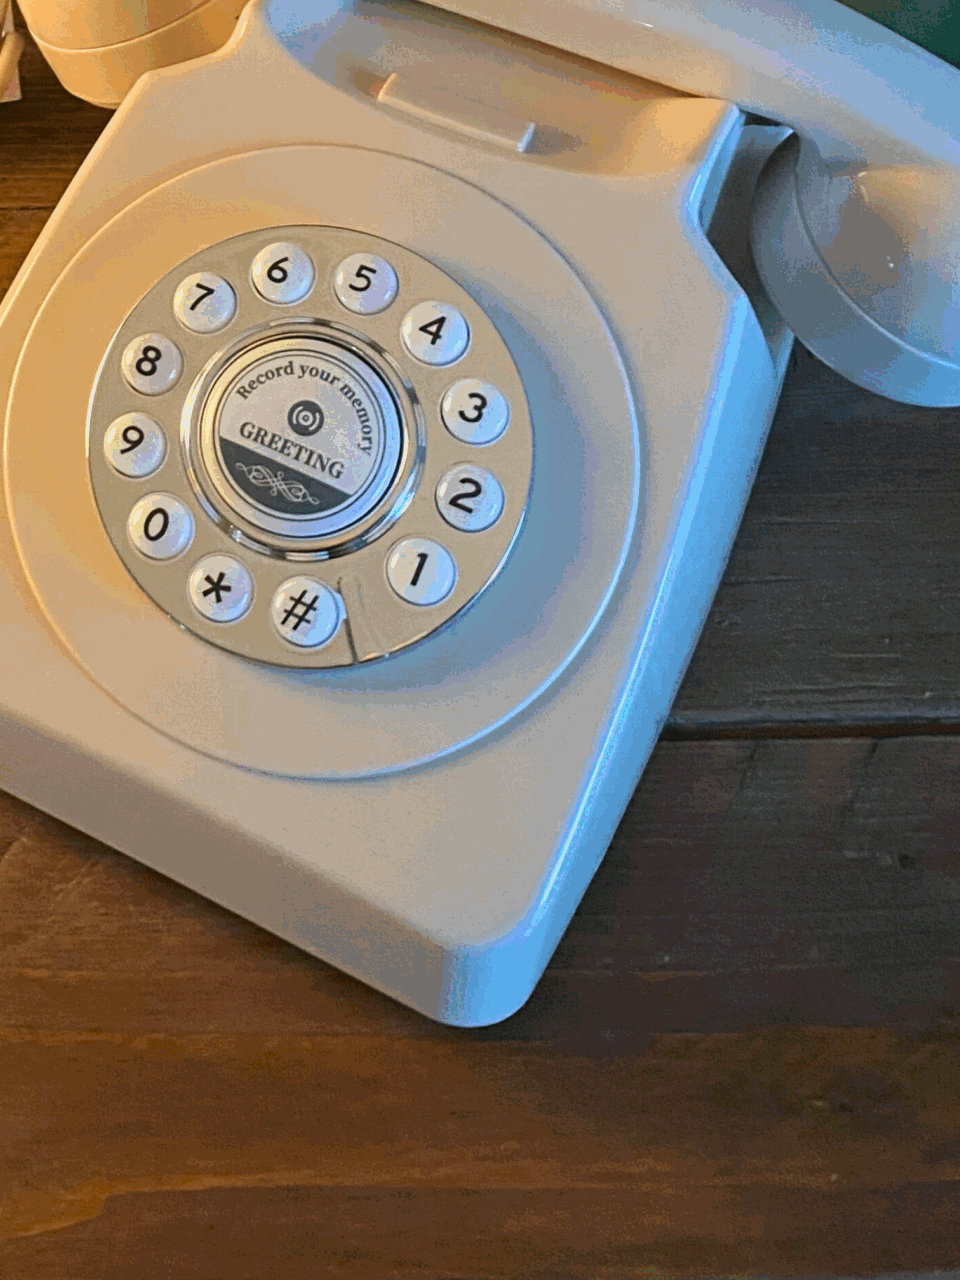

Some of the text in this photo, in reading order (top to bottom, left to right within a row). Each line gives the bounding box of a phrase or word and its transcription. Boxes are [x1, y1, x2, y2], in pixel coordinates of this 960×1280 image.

[266, 256, 290, 284] 6
[348, 264, 377, 292] 5
[189, 283, 215, 312] 7
[418, 315, 447, 346] 4
[135, 345, 163, 377] 8
[235, 360, 374, 456] Record your memory
[458, 392, 488, 423] 3
[120, 425, 145, 455] 9
[239, 420, 345, 480] GREETING
[448, 477, 482, 514] 2
[143, 507, 170, 542] 0
[409, 552, 429, 587] 1
